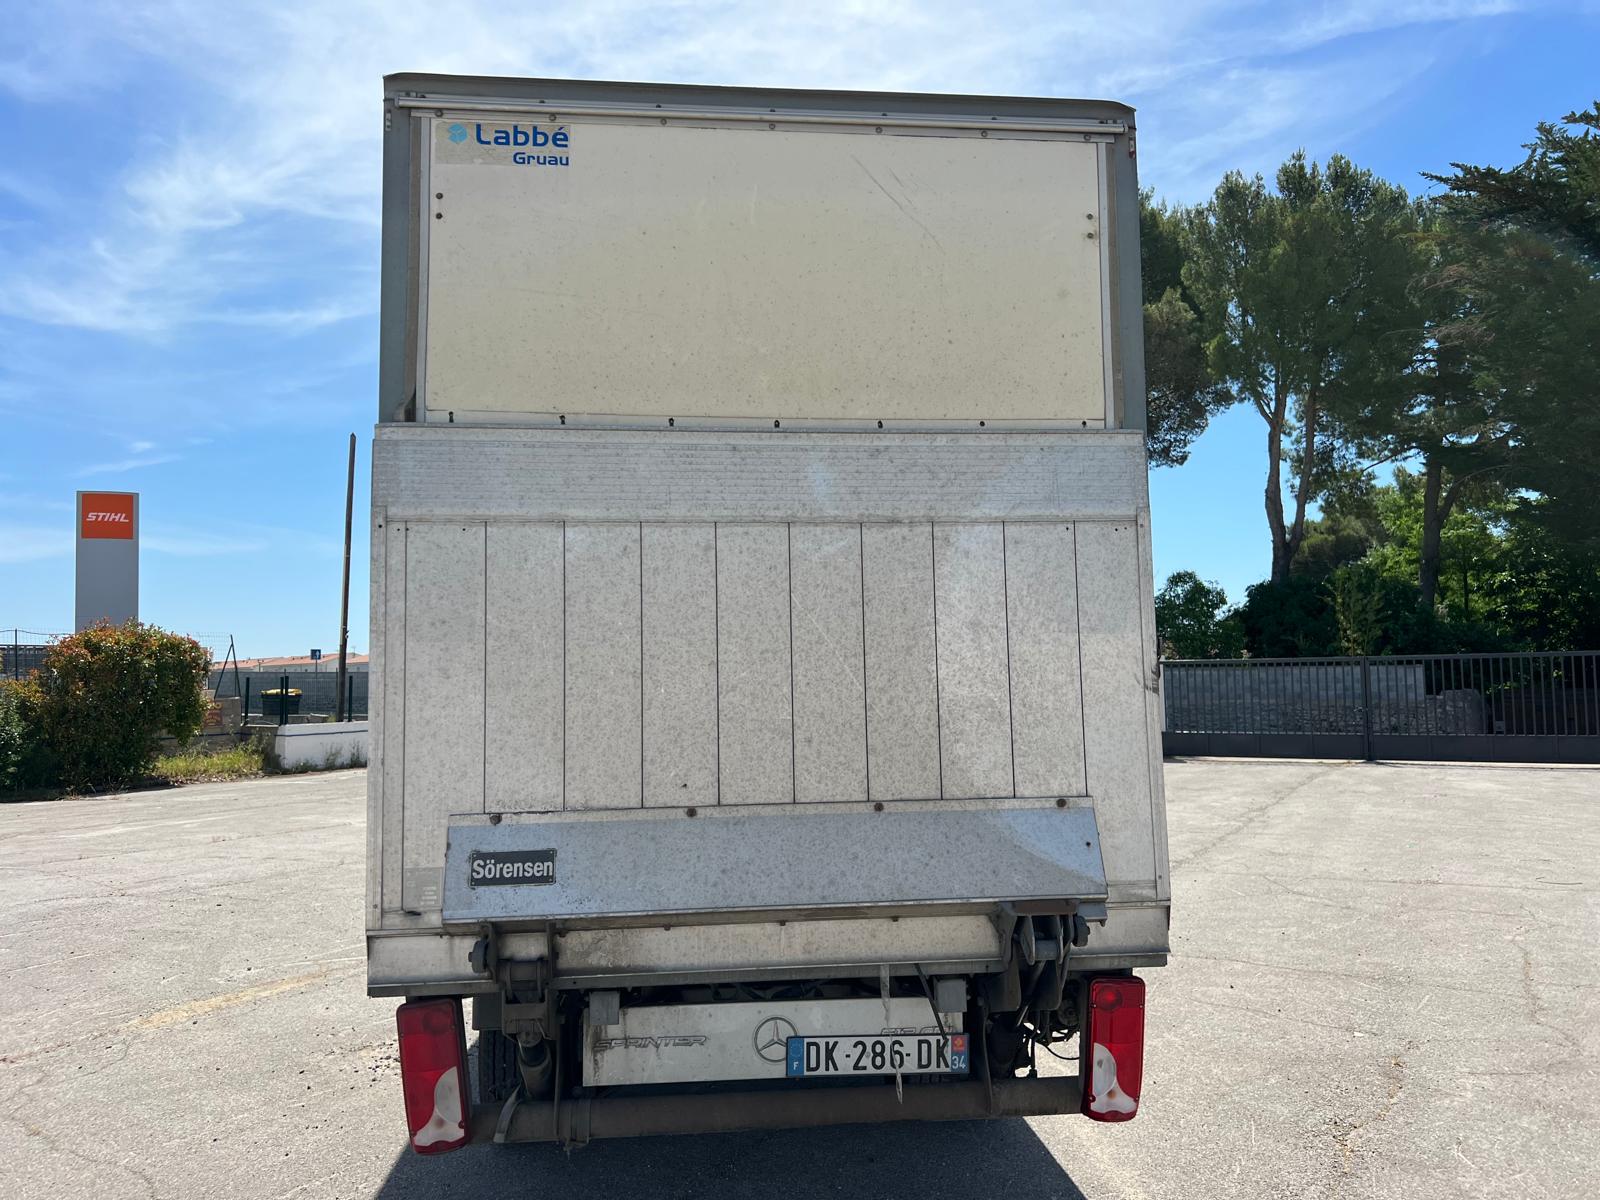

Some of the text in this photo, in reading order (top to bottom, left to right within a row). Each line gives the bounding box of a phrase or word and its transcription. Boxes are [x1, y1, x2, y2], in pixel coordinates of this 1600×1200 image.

[475, 123, 569, 148] Labbé
[513, 152, 569, 166] Gruau
[86, 512, 129, 523] STIHL
[472, 859, 553, 879] Sörensen
[592, 1035, 707, 1051] SPRINTER
[793, 1061, 799, 1070] F
[952, 1055, 966, 1069] 34
